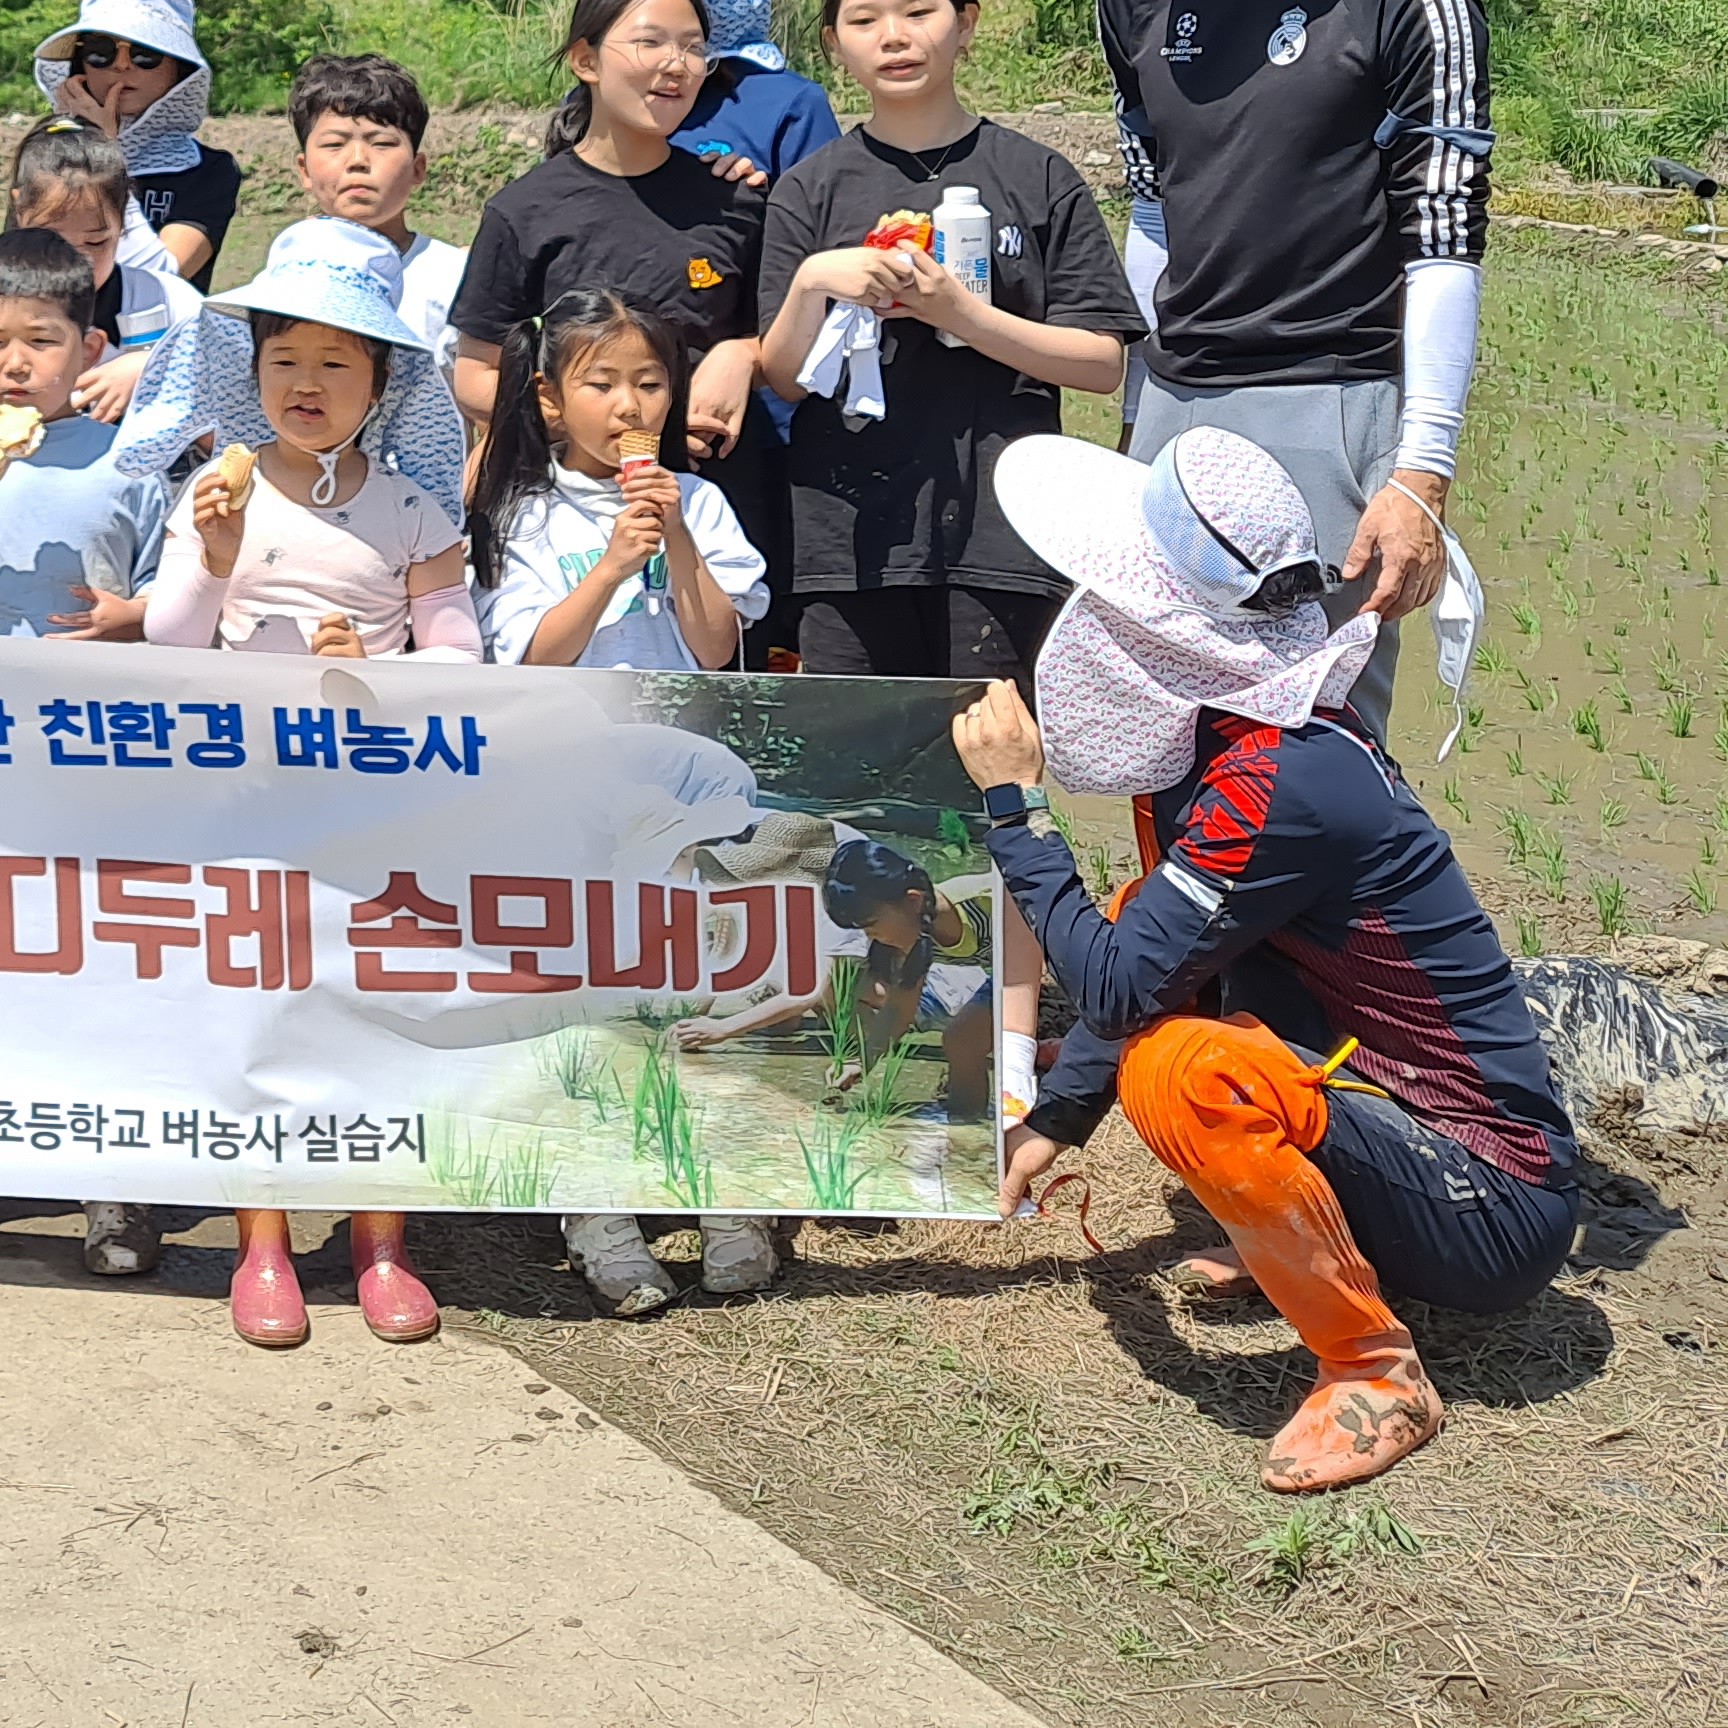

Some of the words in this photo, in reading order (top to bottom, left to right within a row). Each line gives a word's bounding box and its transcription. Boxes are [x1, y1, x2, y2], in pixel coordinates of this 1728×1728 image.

[962, 279, 988, 293] ATER
[38, 699, 247, 769] 친환경
[272, 706, 487, 776] 벼농사
[347, 871, 823, 997] 손모내기
[162, 1109, 288, 1163] 벼농사
[297, 1113, 426, 1163] 실습지
